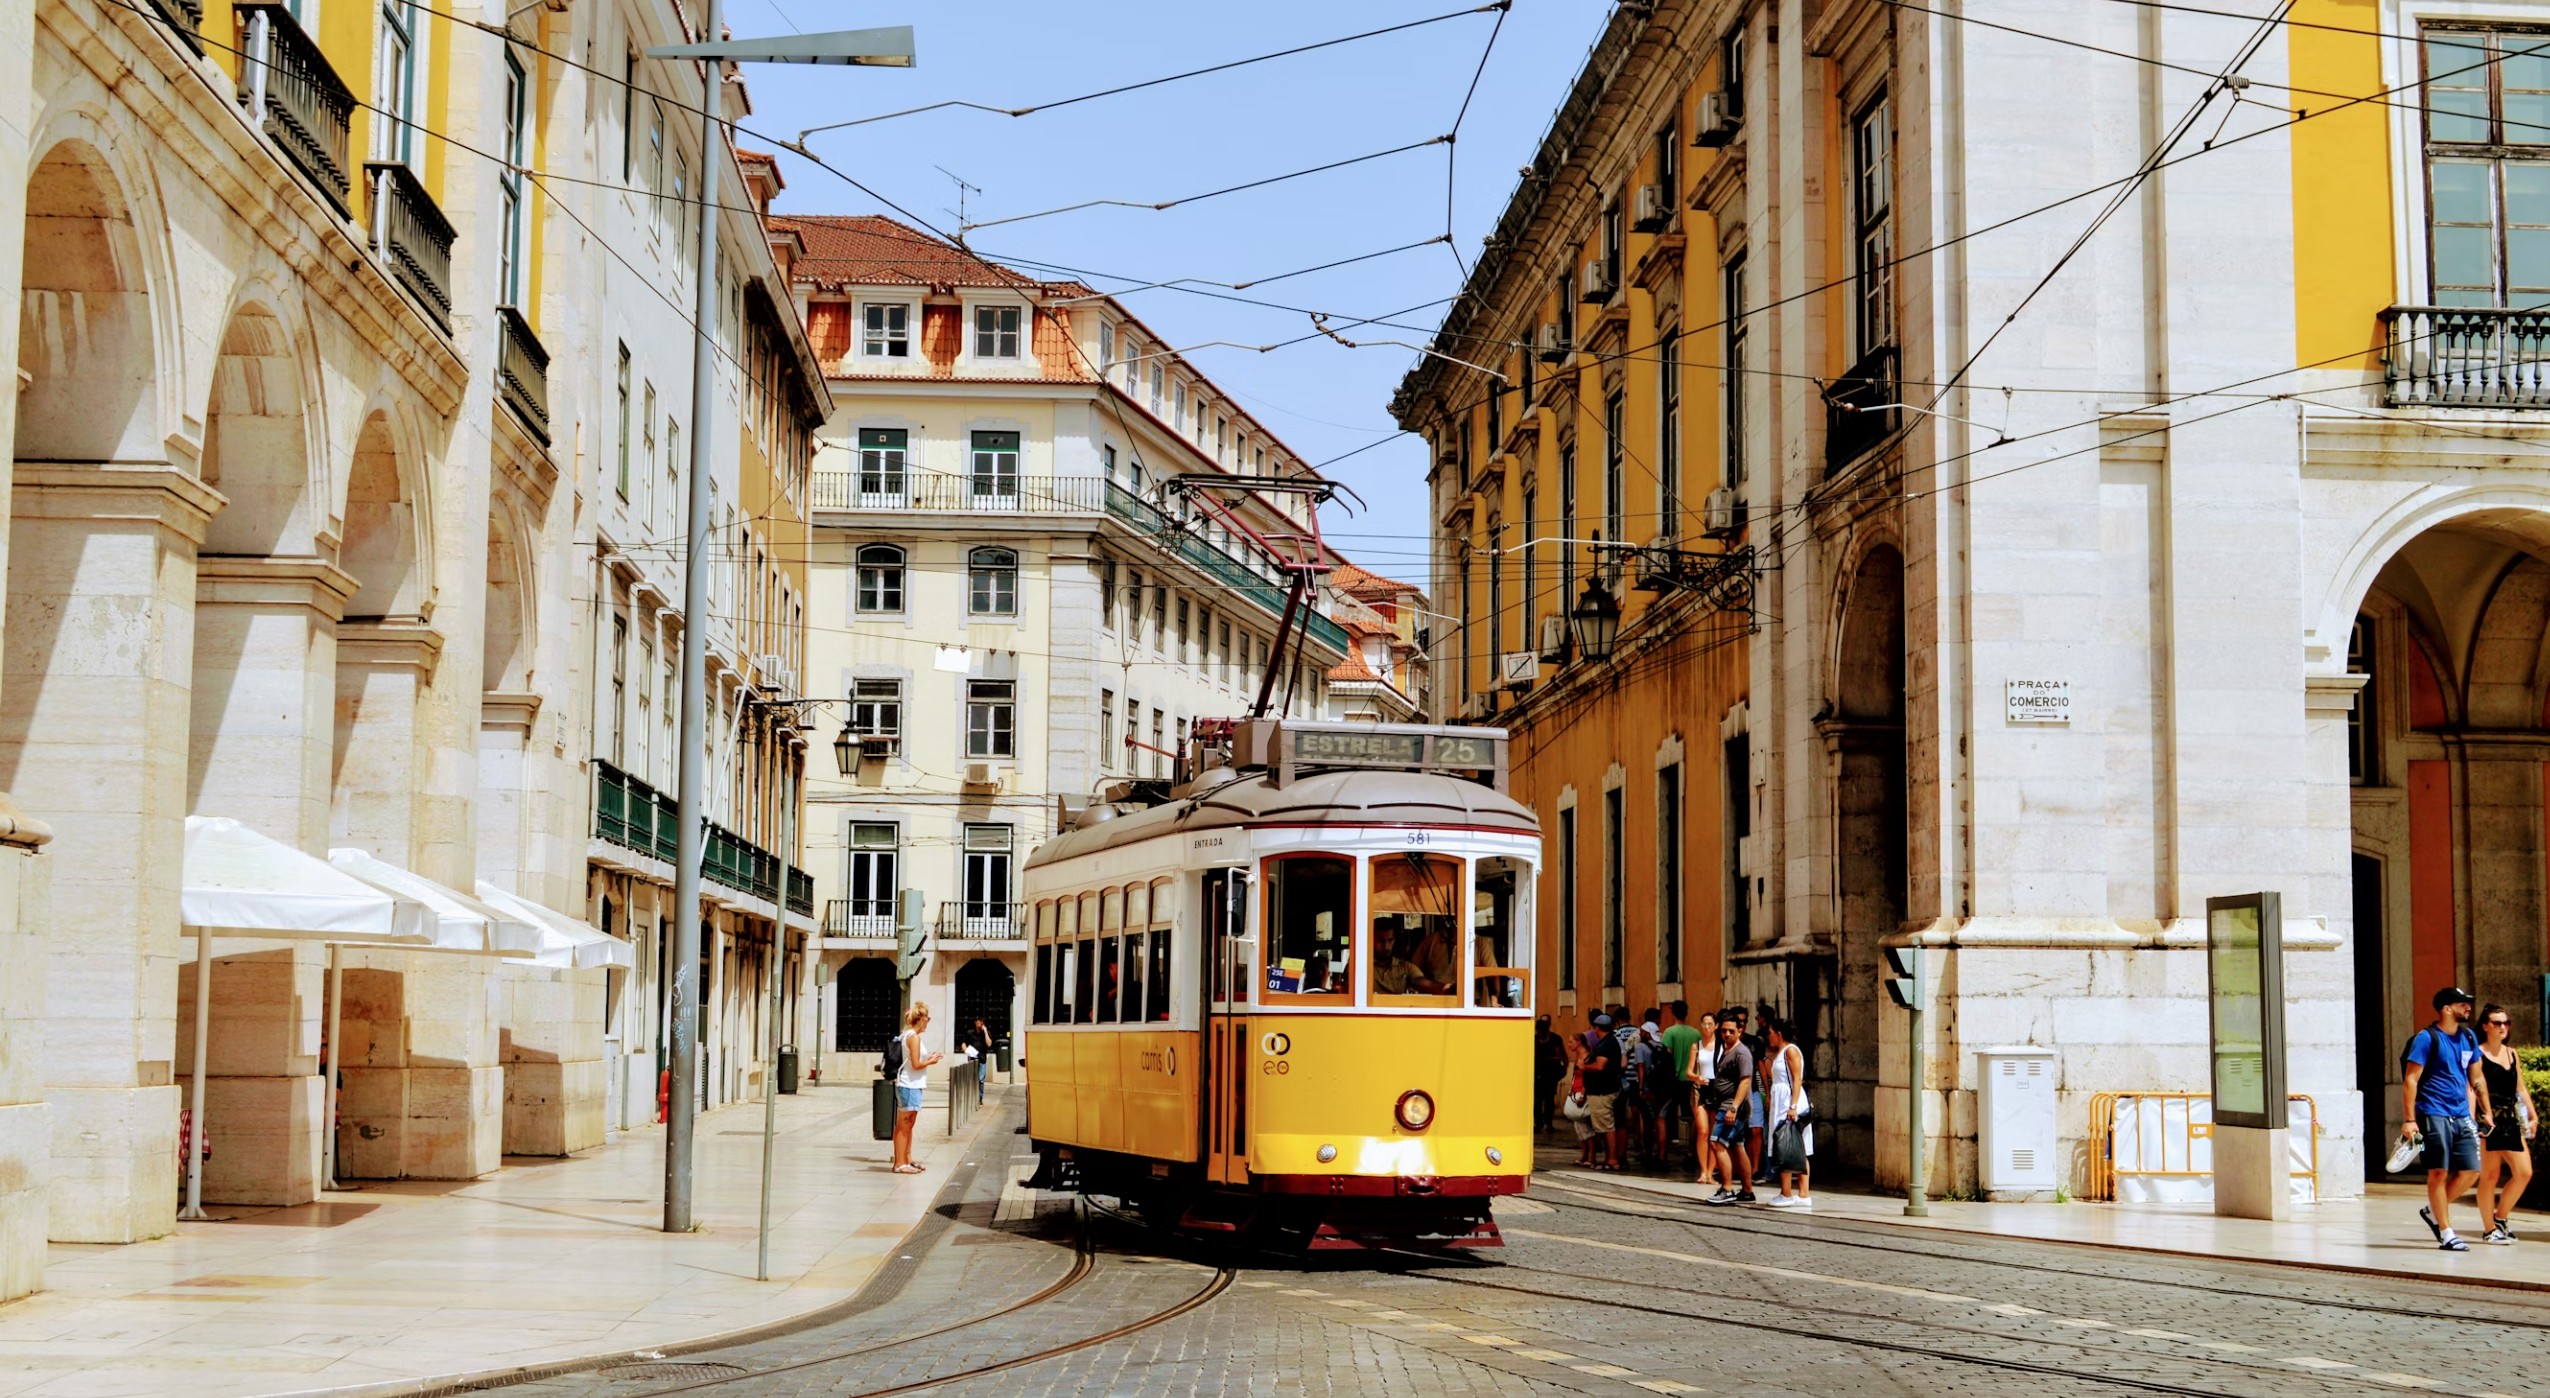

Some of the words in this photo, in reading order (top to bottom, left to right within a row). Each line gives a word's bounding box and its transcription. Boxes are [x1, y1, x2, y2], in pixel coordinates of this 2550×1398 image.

[2018, 681, 2060, 691] PRAÇA
[2009, 696, 2069, 707] COMERCIO
[1303, 735, 1412, 754] ESTRELA
[1438, 737, 1475, 763] 25
[1194, 837, 1223, 849] ENTRADA
[1406, 832, 1430, 845] 581
[1271, 968, 1284, 977] 25E
[1268, 979, 1281, 990] 01
[1141, 1044, 1162, 1073] carris
